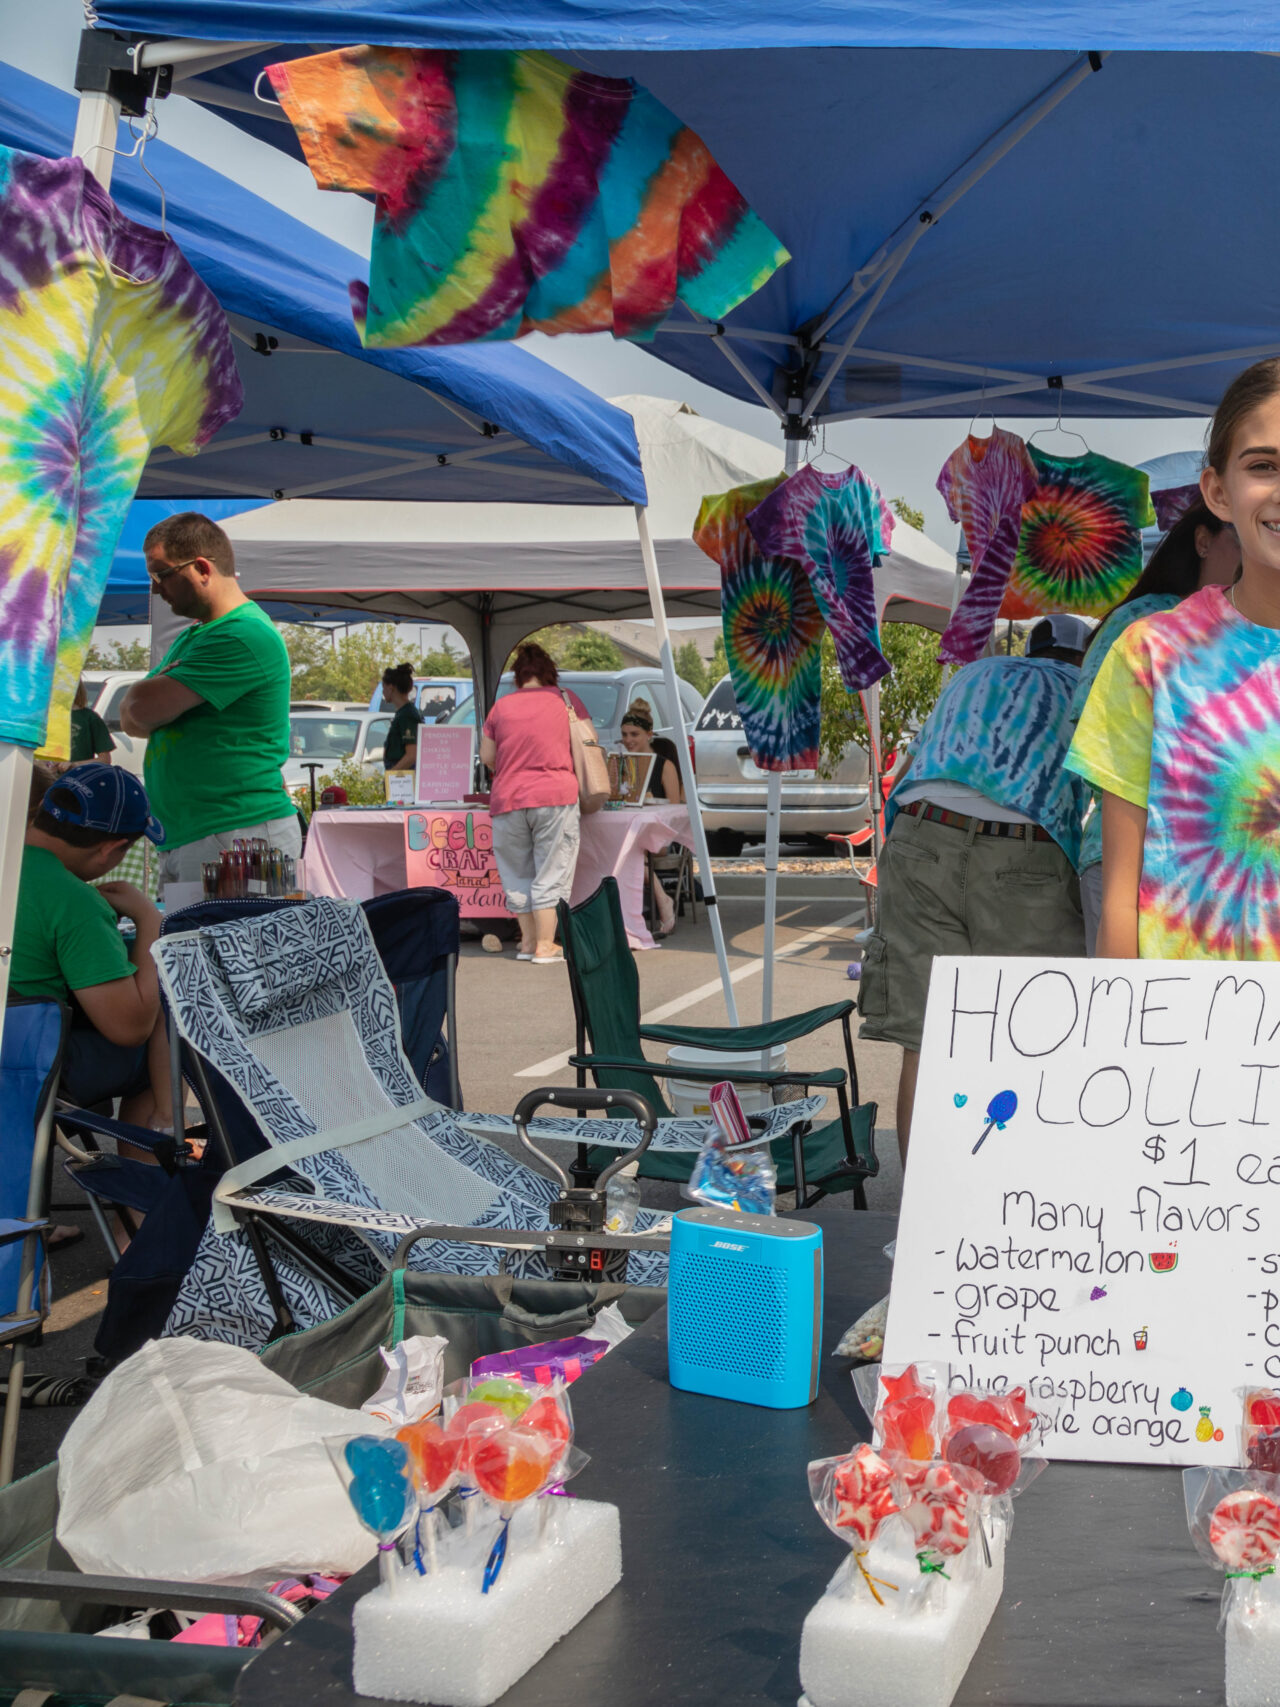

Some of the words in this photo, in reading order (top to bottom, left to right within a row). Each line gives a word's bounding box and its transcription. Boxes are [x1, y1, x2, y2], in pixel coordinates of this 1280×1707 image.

[1139, 1134, 1210, 1186] $1
[1003, 1190, 1103, 1242] Many
[1130, 1186, 1260, 1232] flavors
[711, 1241, 747, 1252] BOSE
[955, 1284, 1060, 1322] grape
[951, 1319, 1026, 1355] fruit
[1035, 1328, 1120, 1367] punch
[1029, 1371, 1160, 1415] raspberry
[1093, 1418, 1190, 1447] orange
